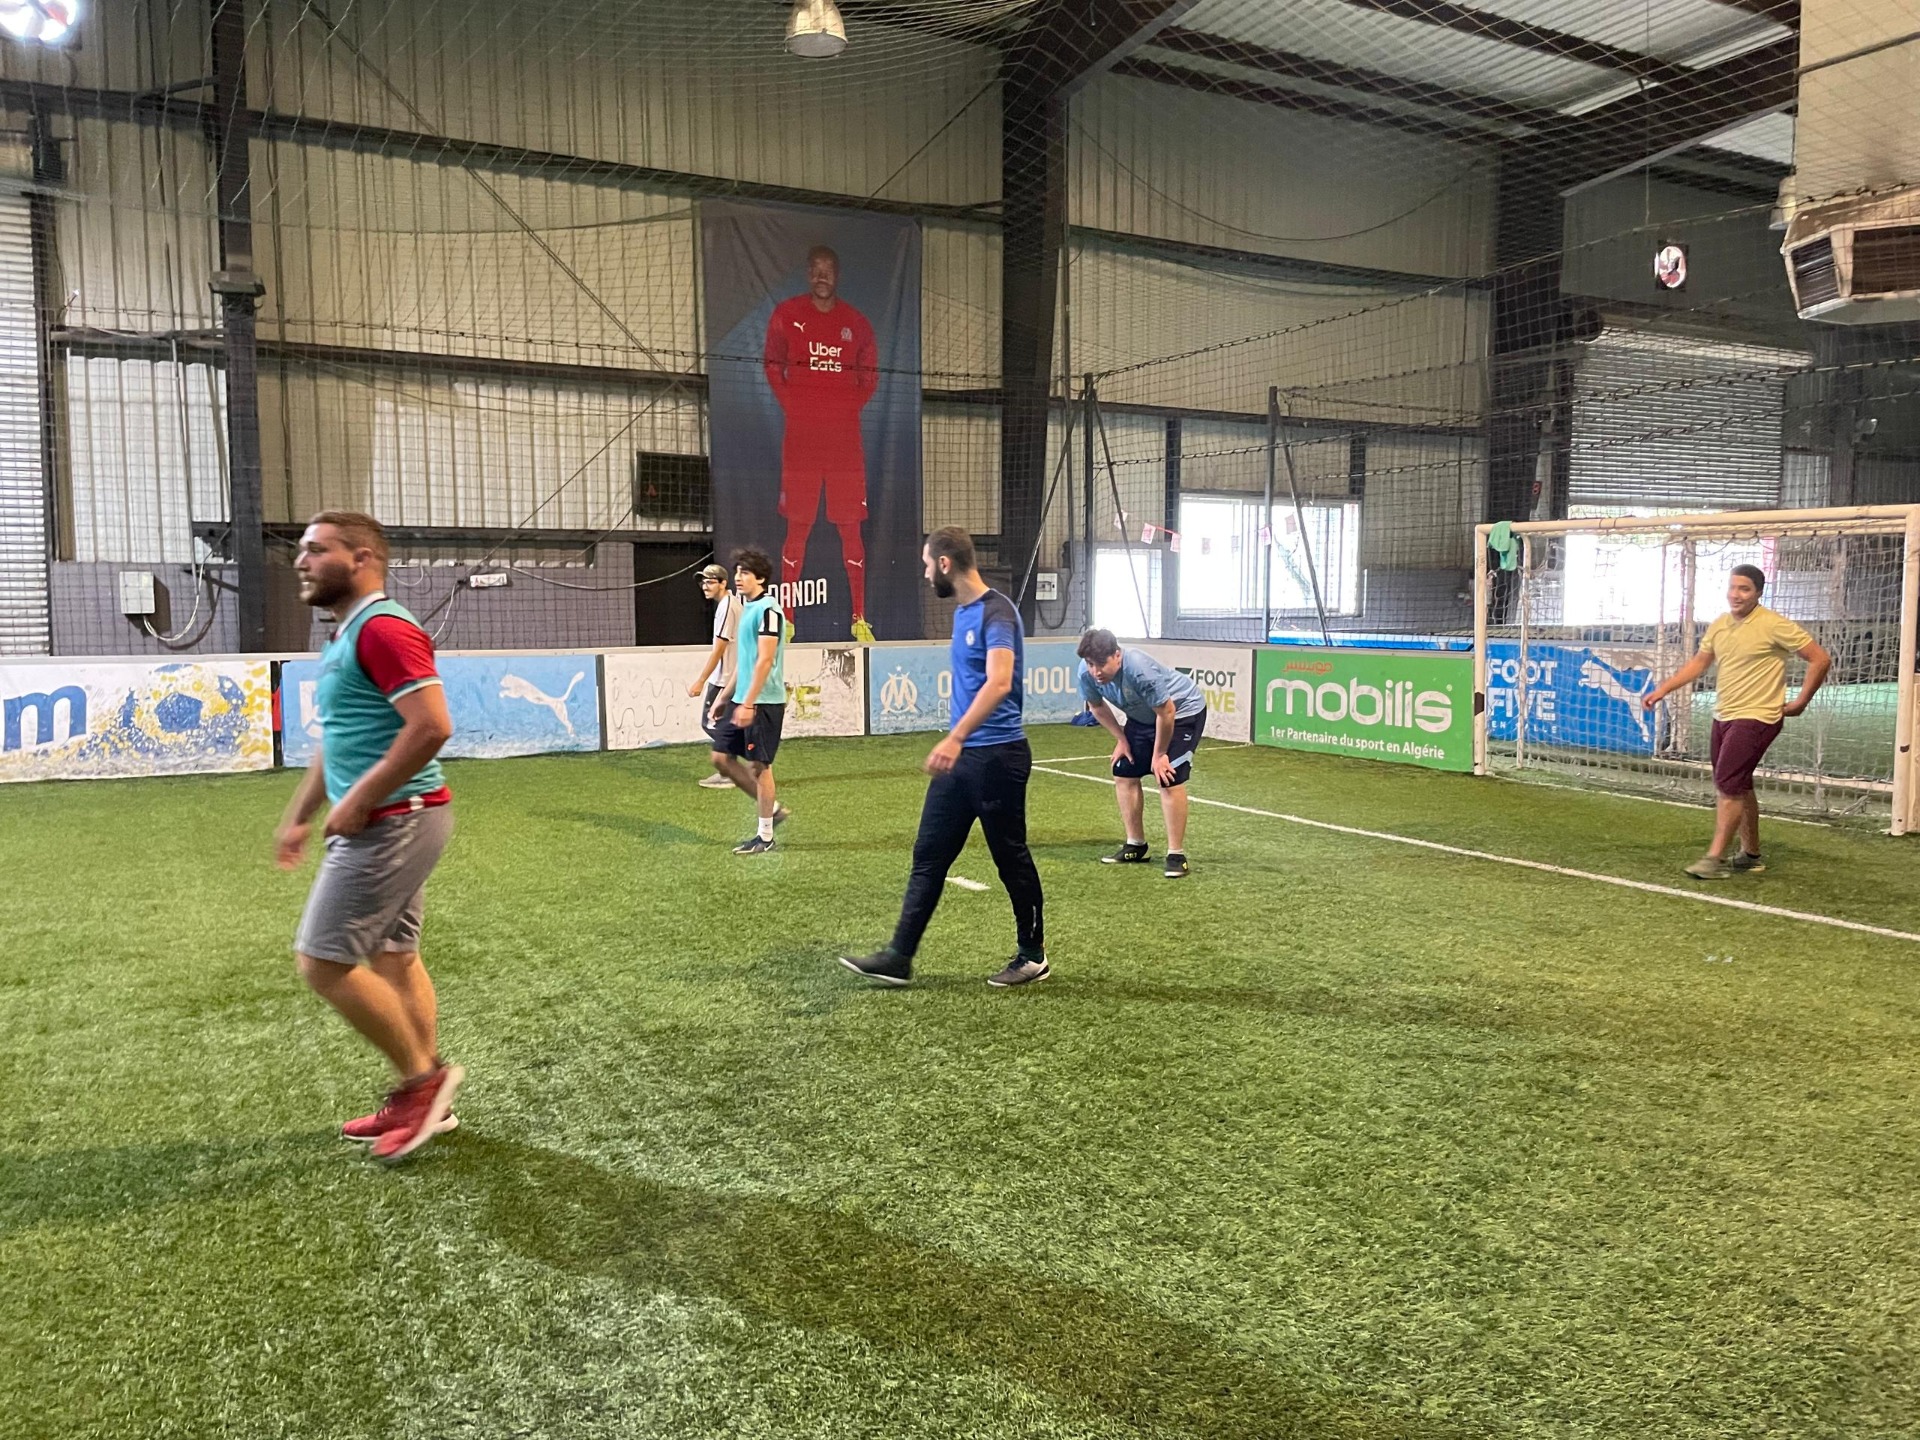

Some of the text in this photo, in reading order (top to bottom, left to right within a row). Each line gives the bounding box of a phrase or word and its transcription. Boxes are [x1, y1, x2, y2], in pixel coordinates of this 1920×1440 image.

[808, 341, 842, 357] Uber
[809, 357, 842, 372] Eats
[1196, 669, 1236, 688] FOOT
[1487, 658, 1557, 686] FOOT
[1202, 689, 1235, 713] IVE
[1266, 677, 1452, 733] mobilis
[1487, 687, 1556, 721] FIVE
[1270, 726, 1445, 759] 1er Partenaire du sport en Algérie
